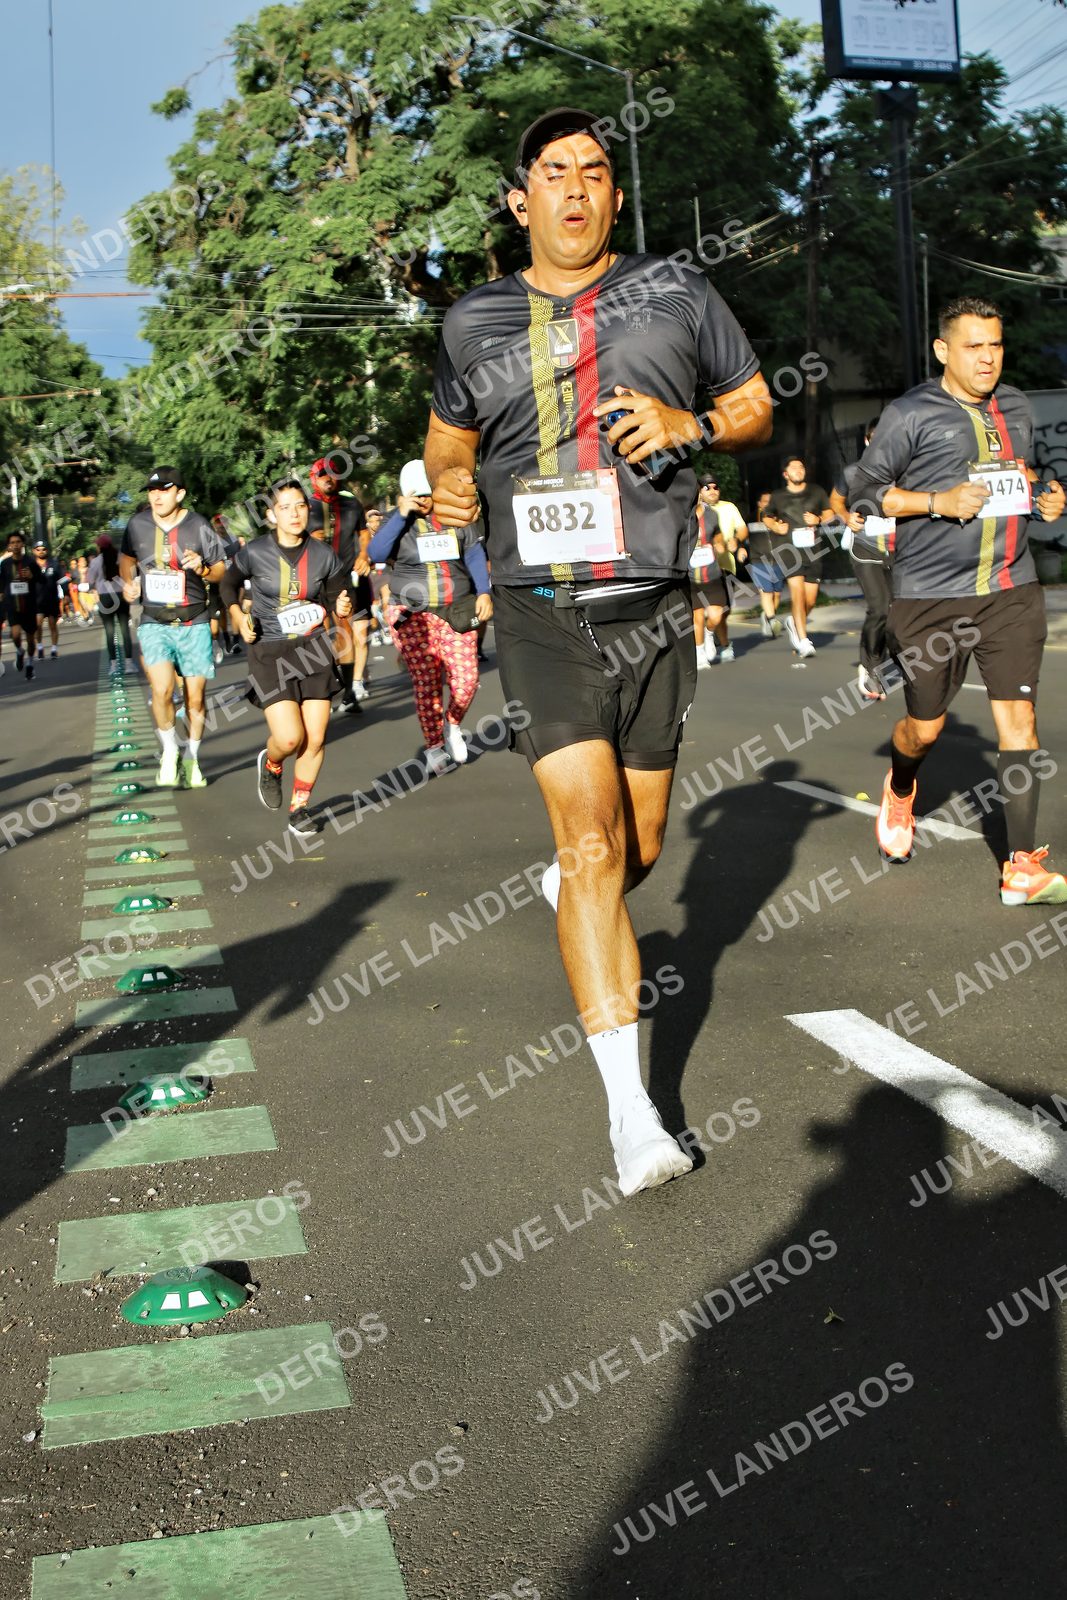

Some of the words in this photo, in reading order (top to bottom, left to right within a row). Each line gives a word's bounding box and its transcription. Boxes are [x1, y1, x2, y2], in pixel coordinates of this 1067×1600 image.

[527, 501, 597, 533] 8832
[424, 538, 450, 549] 4348
[148, 578, 180, 592] 10958
[282, 608, 319, 628] 12011
